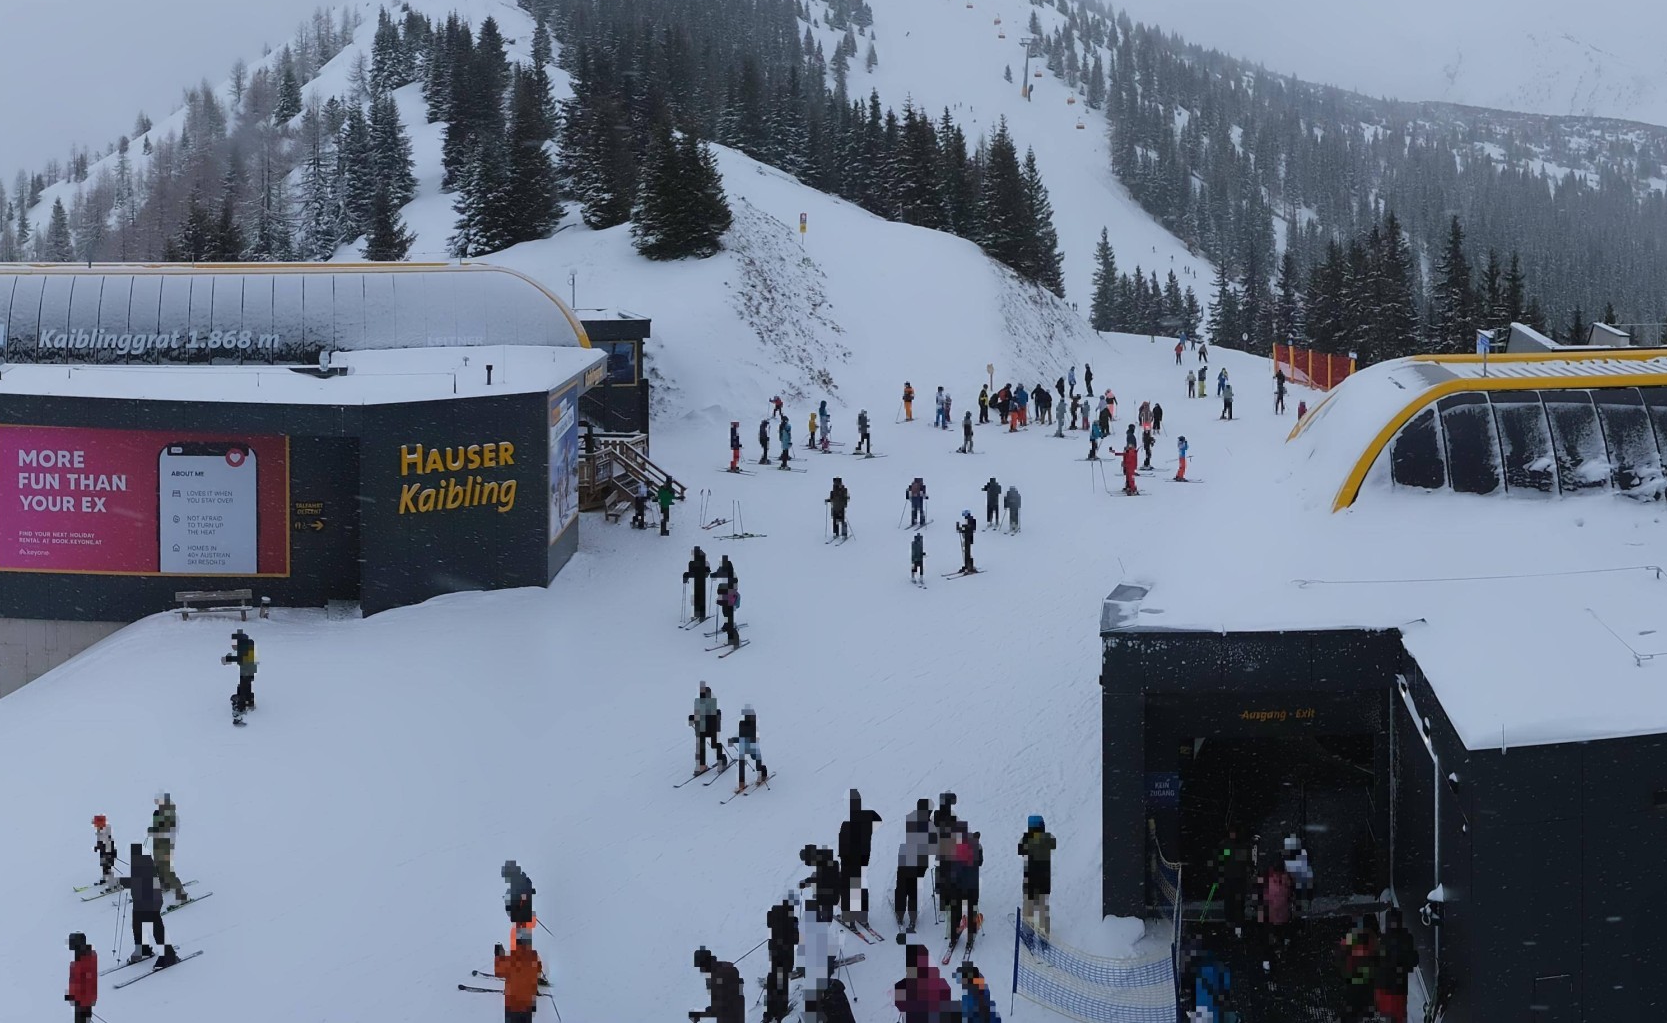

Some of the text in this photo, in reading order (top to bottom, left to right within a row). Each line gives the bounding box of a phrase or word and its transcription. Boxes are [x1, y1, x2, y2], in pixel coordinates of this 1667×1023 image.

[39, 329, 280, 355] Kaiblinggrat 1.868 m
[18, 449, 85, 468] MORE
[400, 441, 515, 476] HAUSER
[18, 472, 127, 491] FUN THAN
[19, 495, 107, 513] YOUR EX
[399, 476, 517, 514] Kaibling
[1241, 708, 1316, 721] Ausgang Exit
